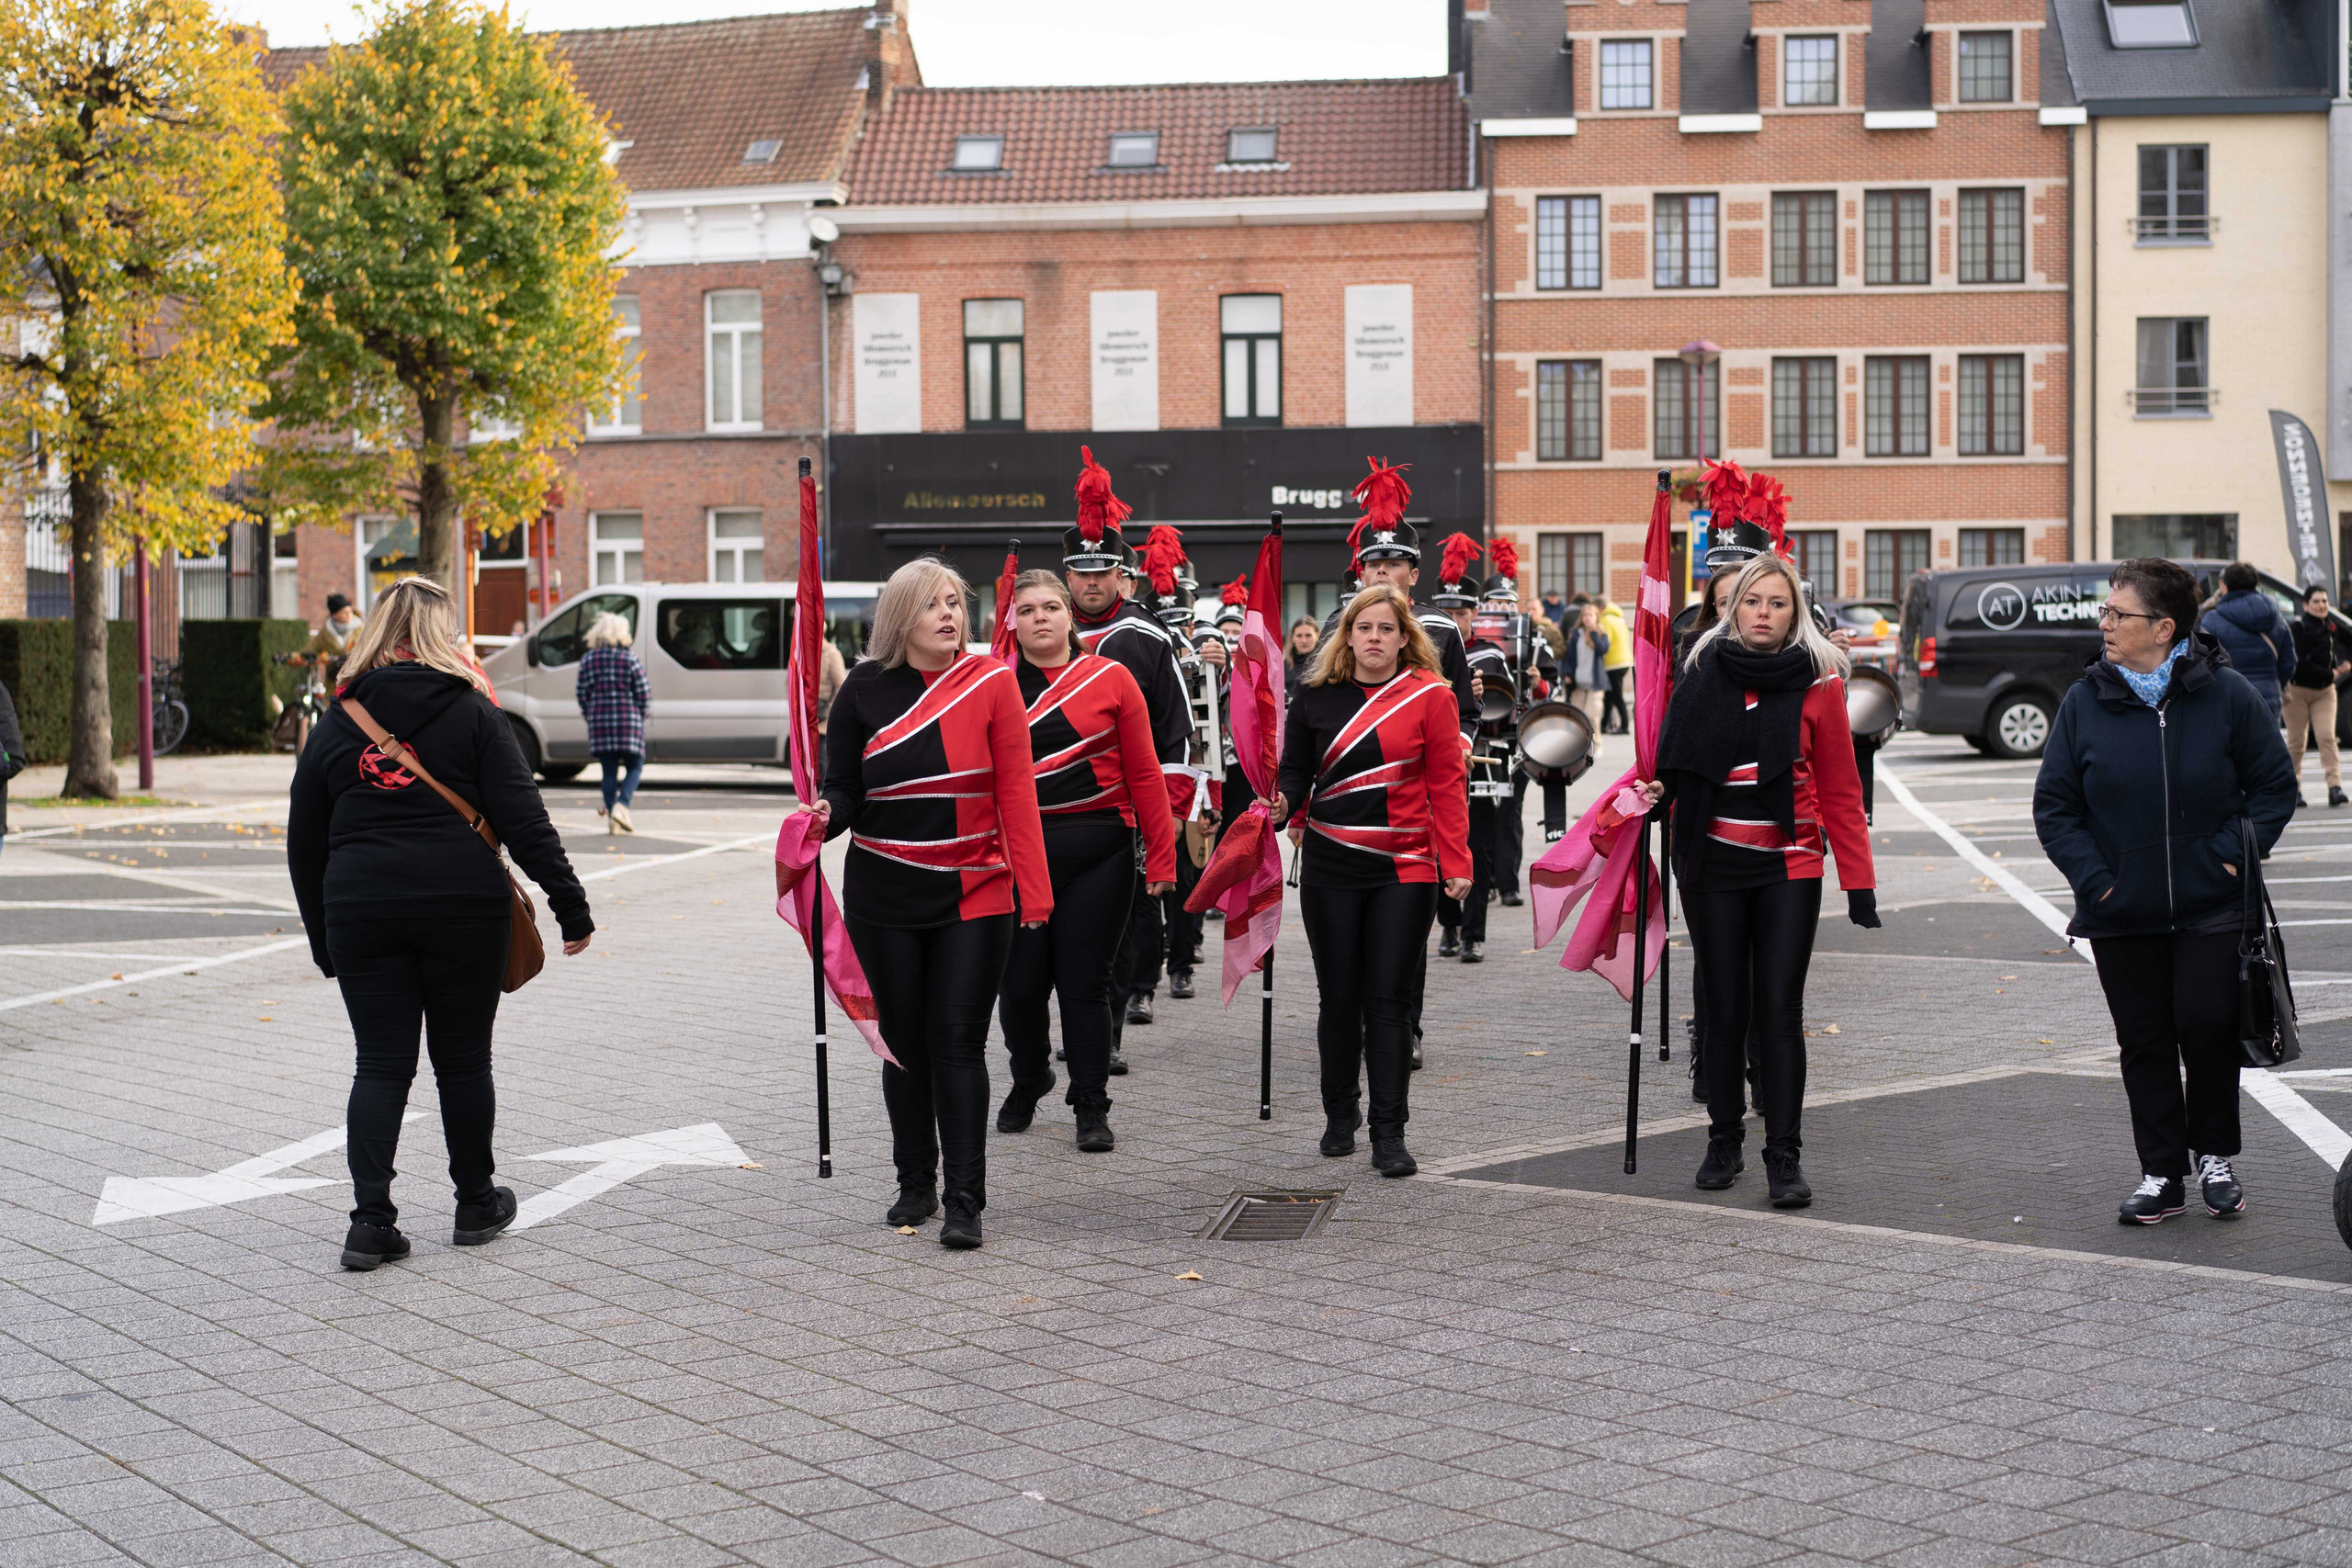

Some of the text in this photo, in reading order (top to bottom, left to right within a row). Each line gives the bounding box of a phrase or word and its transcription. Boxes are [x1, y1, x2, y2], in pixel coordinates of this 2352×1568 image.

[1693, 515, 1709, 545] P
[2031, 582, 2082, 604] AKIN
[1988, 594, 2018, 617] AT
